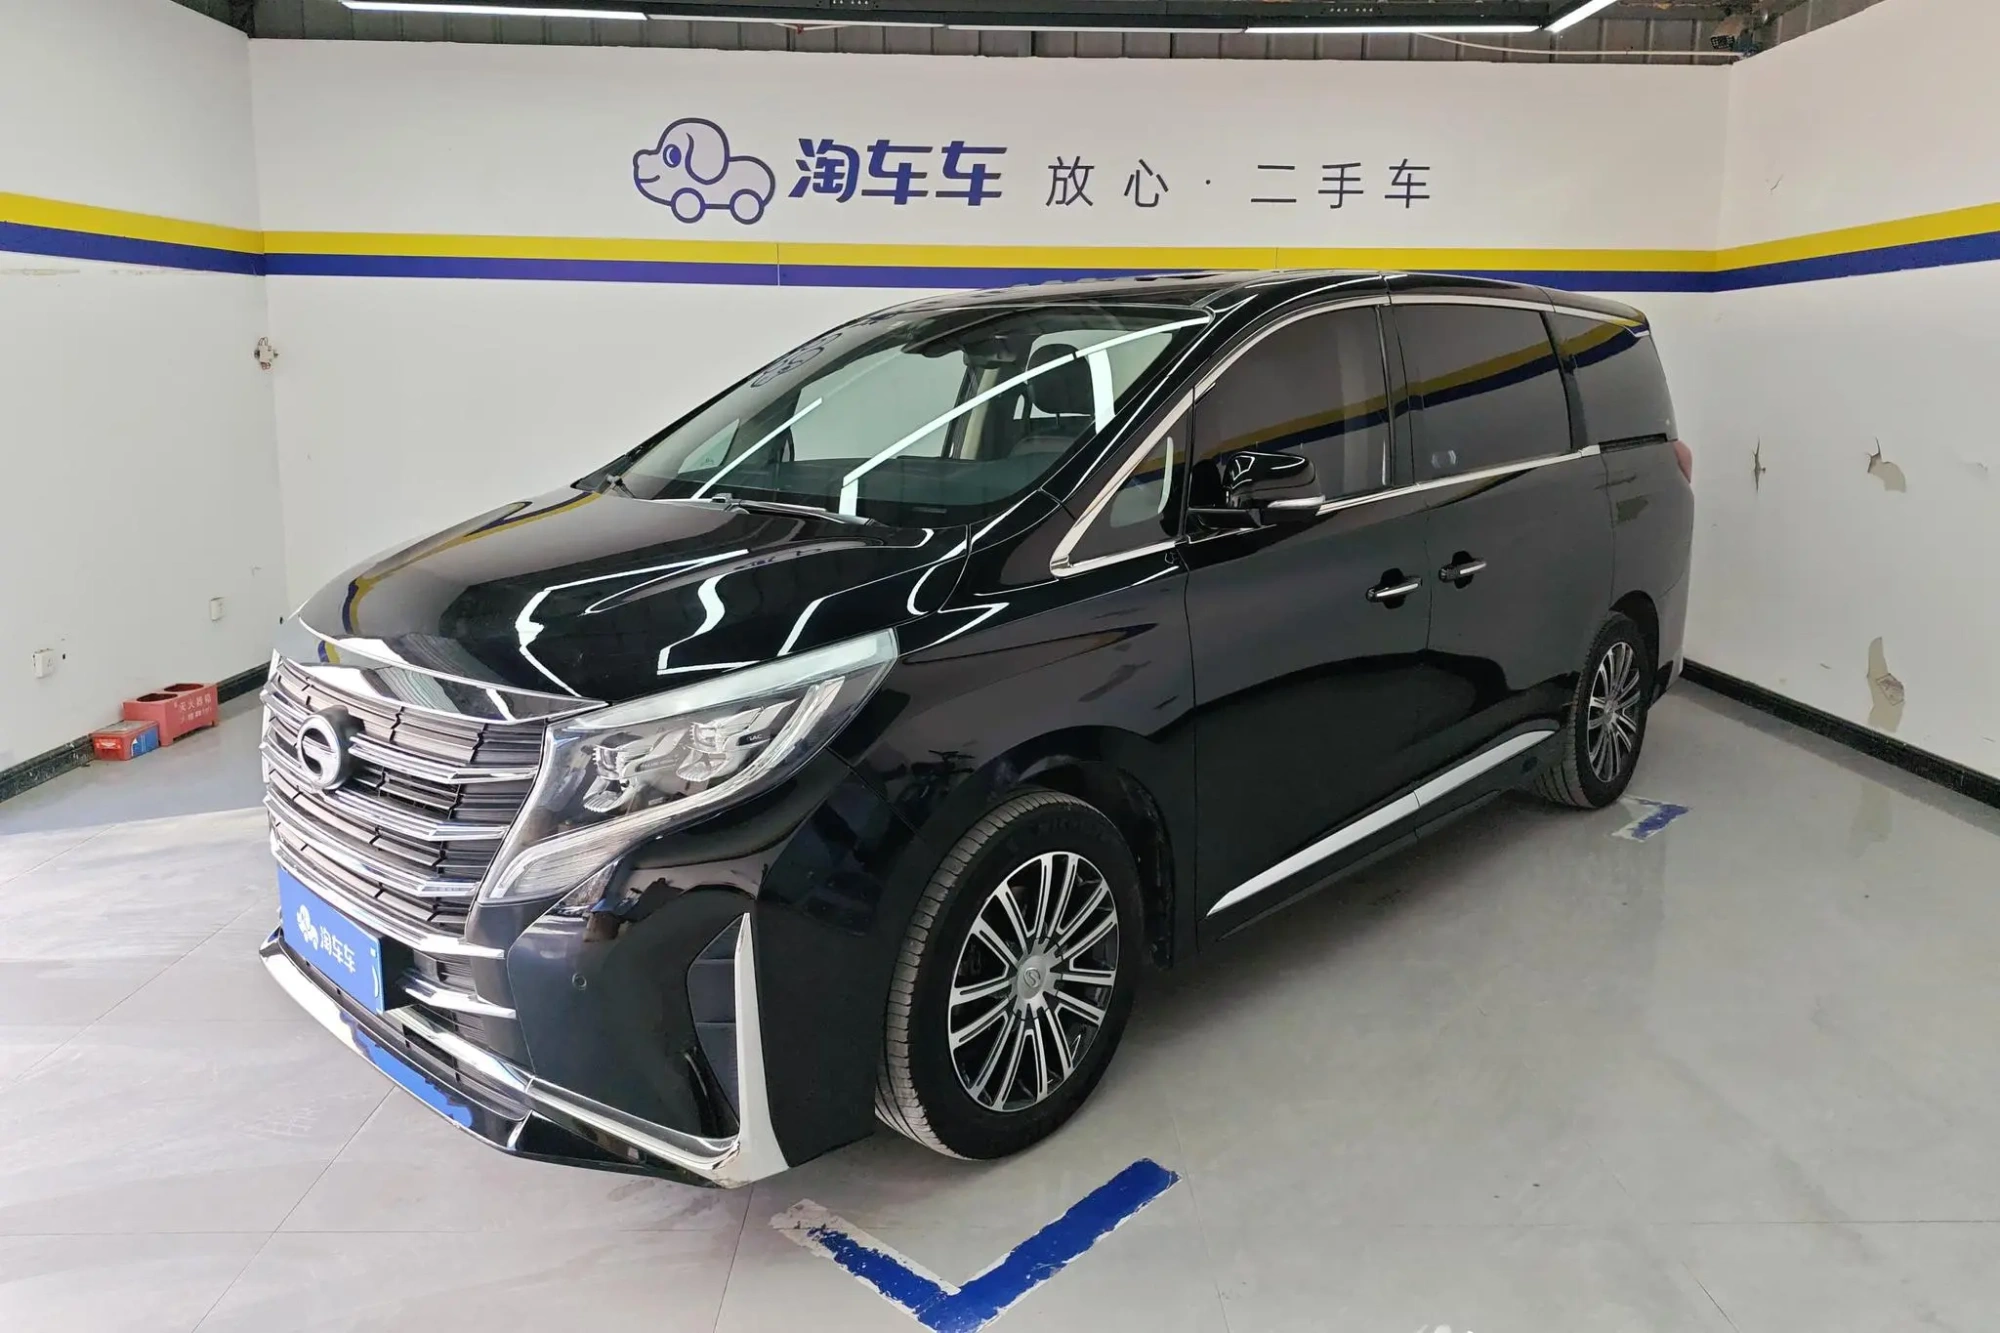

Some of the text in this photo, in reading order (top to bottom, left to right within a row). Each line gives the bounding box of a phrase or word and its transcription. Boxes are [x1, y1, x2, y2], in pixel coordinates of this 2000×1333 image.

[788, 138, 1007, 206] 淘车车
[319, 925, 356, 973] 淘车车
